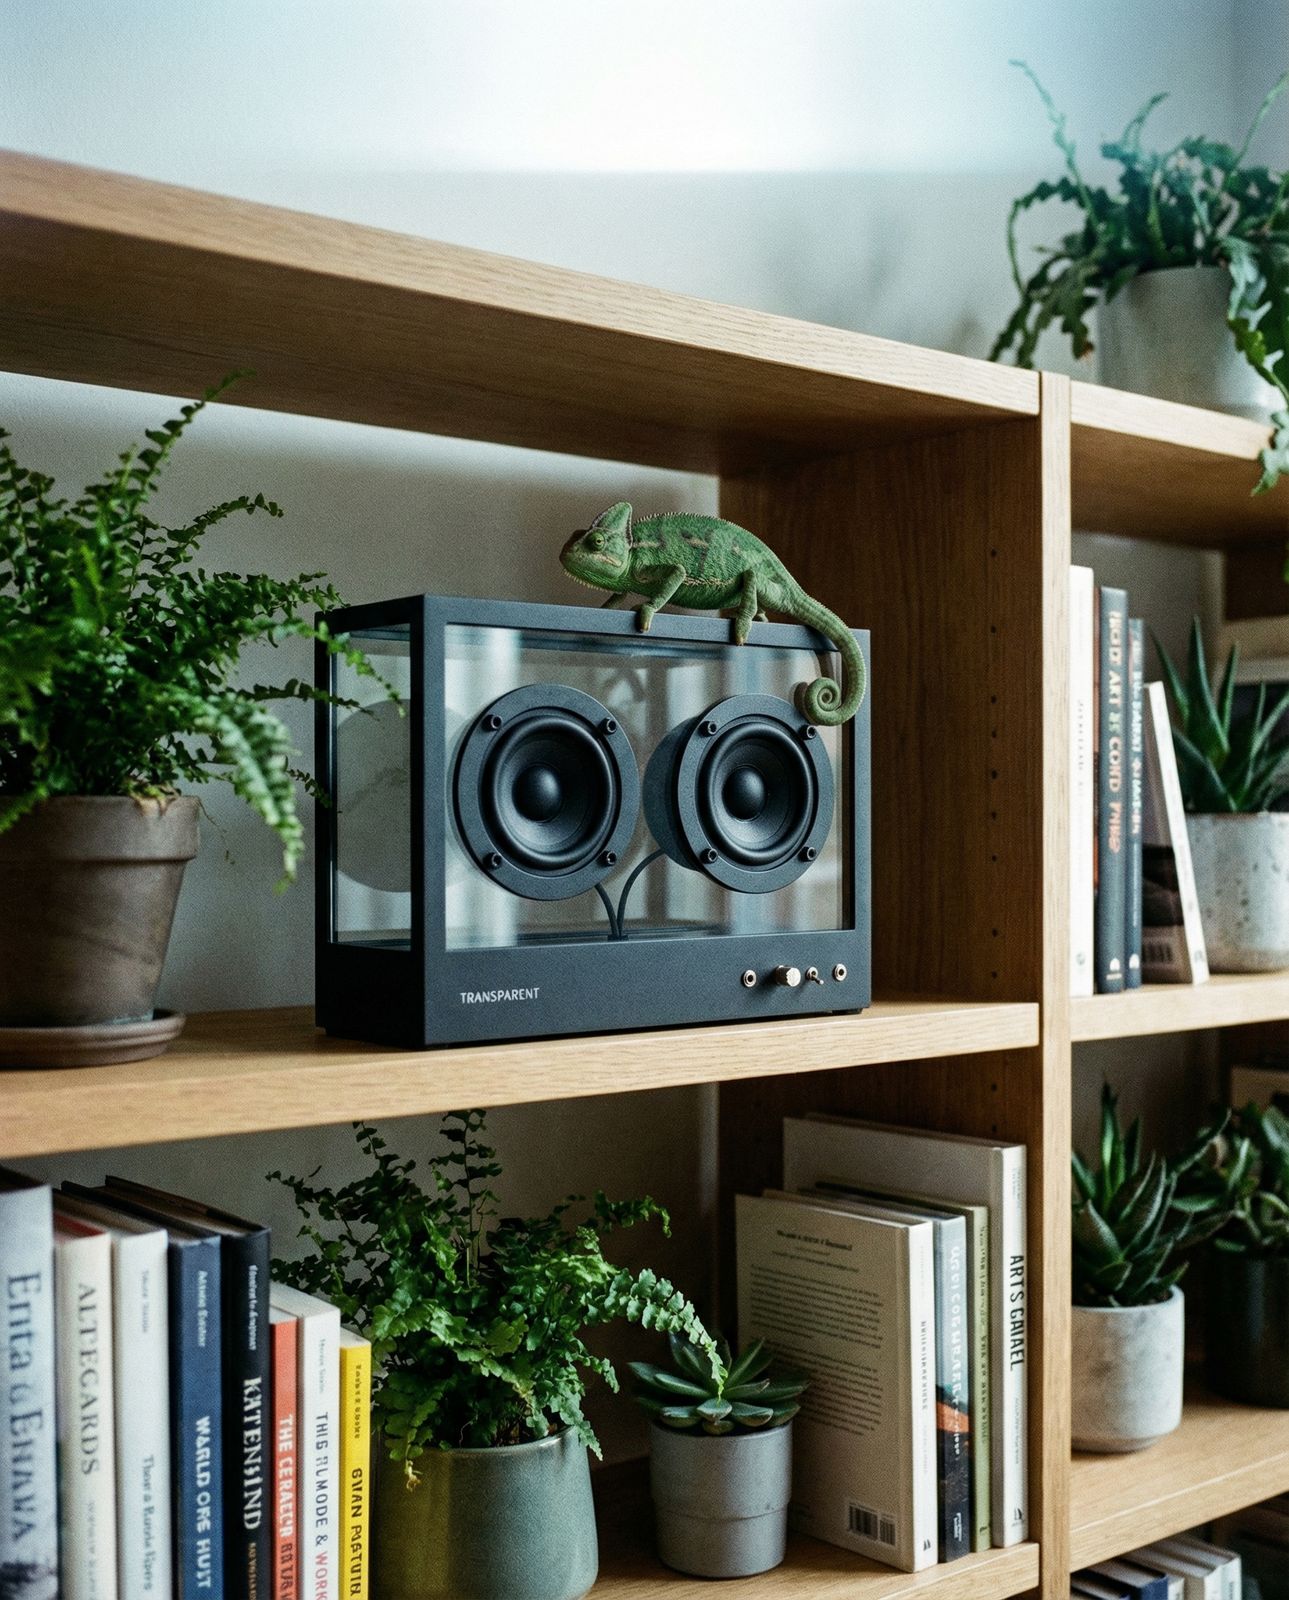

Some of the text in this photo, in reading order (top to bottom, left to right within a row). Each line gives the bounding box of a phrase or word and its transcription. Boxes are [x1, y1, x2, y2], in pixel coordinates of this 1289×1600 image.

[460, 987, 540, 1004] TRANSPARENT
[1009, 1255, 1025, 1303] ARTS
[279, 1413, 294, 1453] THE
